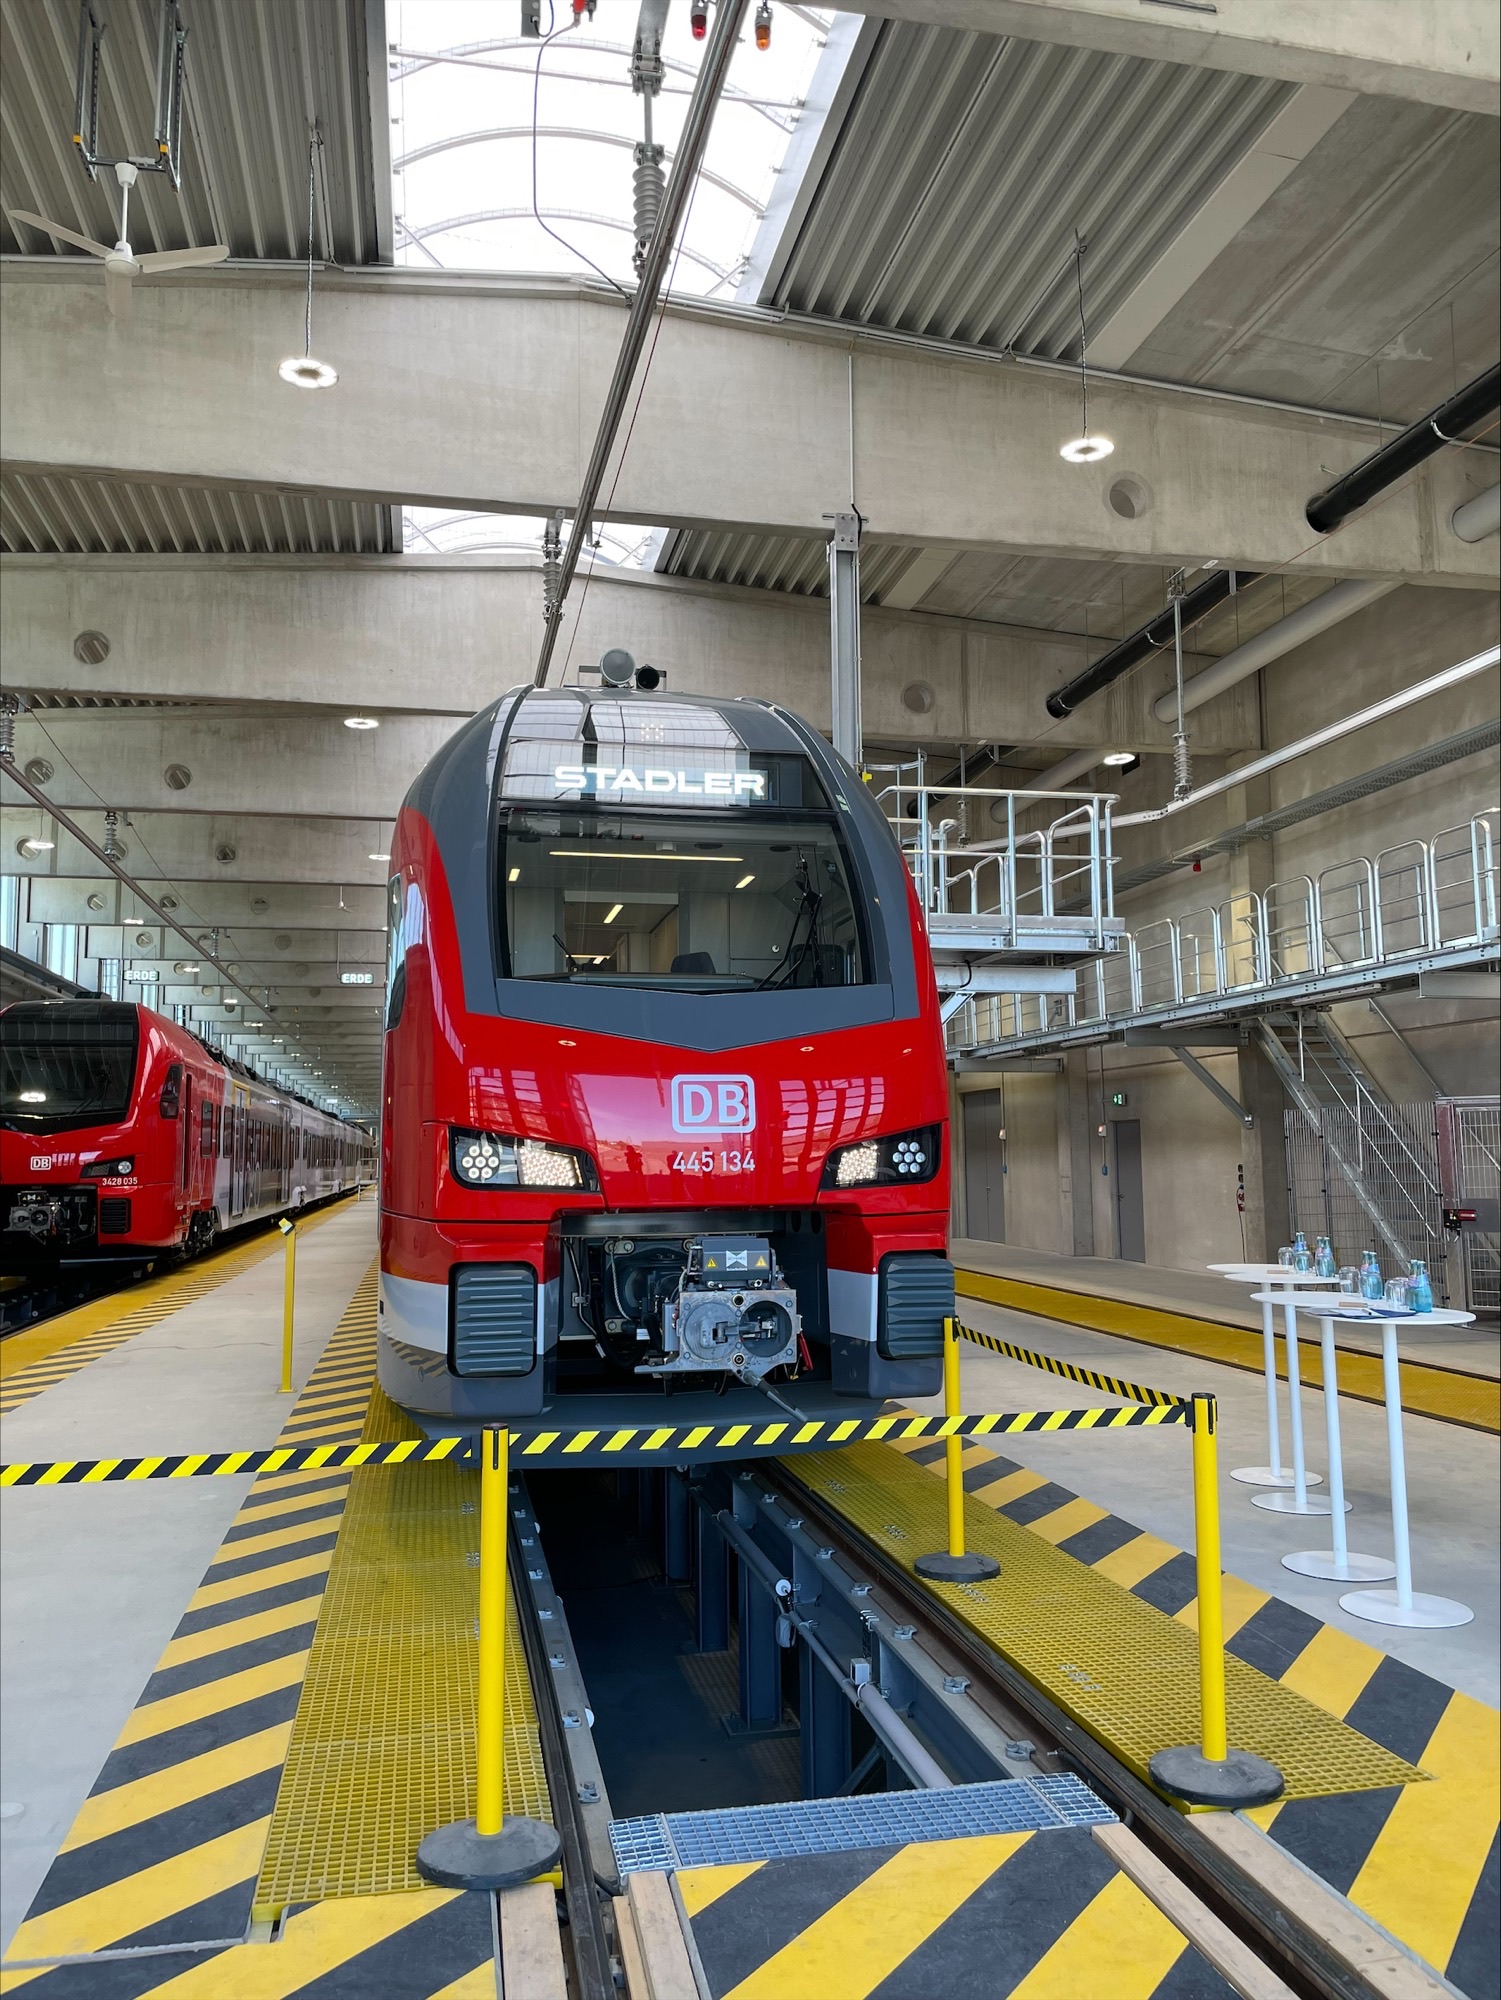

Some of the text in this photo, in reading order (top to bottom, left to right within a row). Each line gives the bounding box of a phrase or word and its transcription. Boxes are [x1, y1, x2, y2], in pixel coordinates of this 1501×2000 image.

[554, 766, 765, 796] STADLER
[126, 970, 156, 981] ERDE
[342, 973, 373, 984] ERDE
[681, 1082, 748, 1125] DB
[32, 1157, 50, 1169] DB
[673, 1150, 755, 1172] 445 134
[102, 1177, 138, 1186] 3428 035
